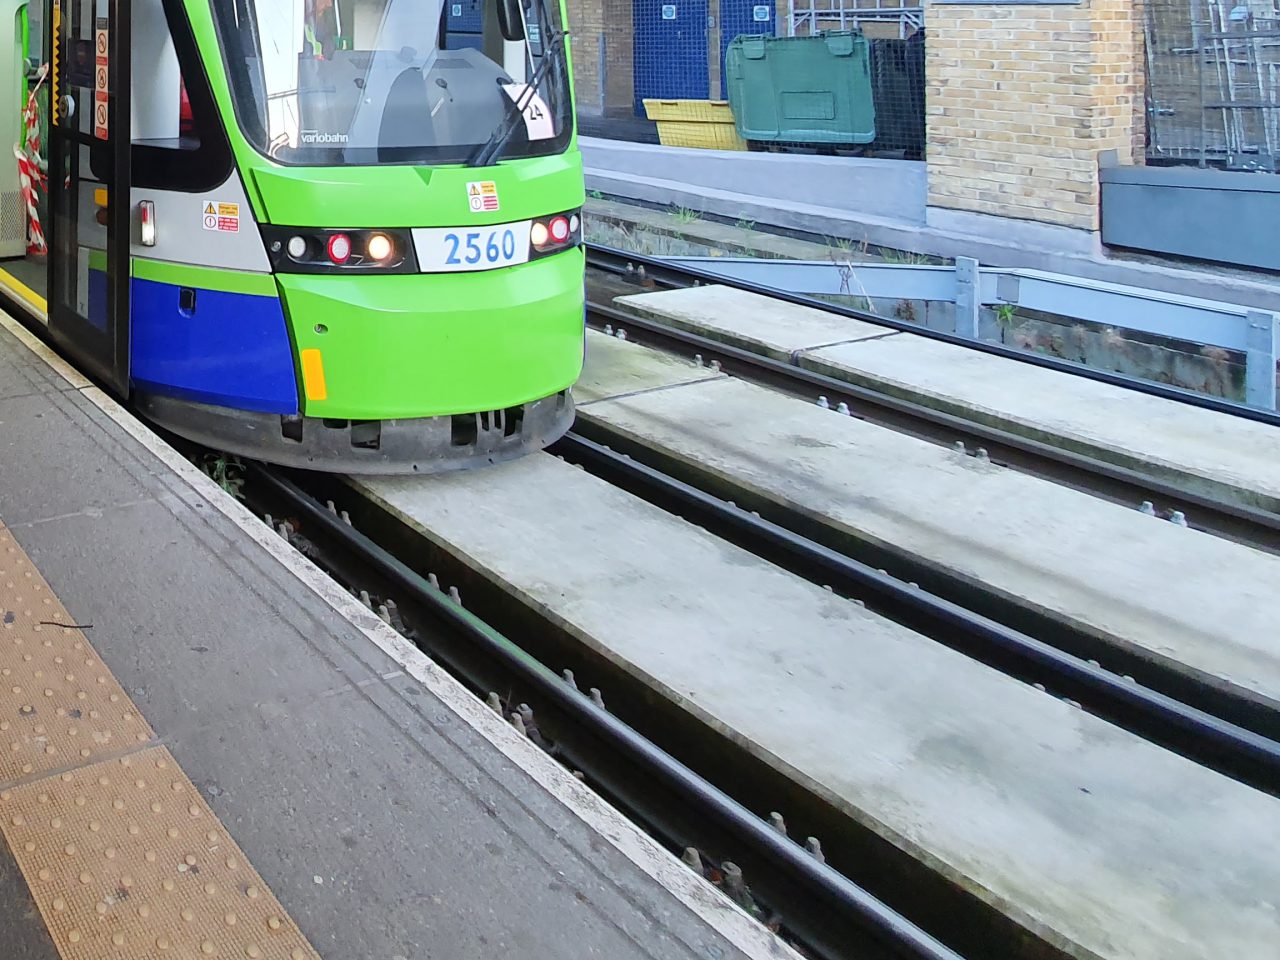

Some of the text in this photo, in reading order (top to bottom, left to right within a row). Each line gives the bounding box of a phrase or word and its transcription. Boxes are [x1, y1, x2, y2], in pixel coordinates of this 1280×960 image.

[528, 103, 544, 121] 24
[300, 130, 349, 143] variobahn
[444, 229, 515, 264] 2560
